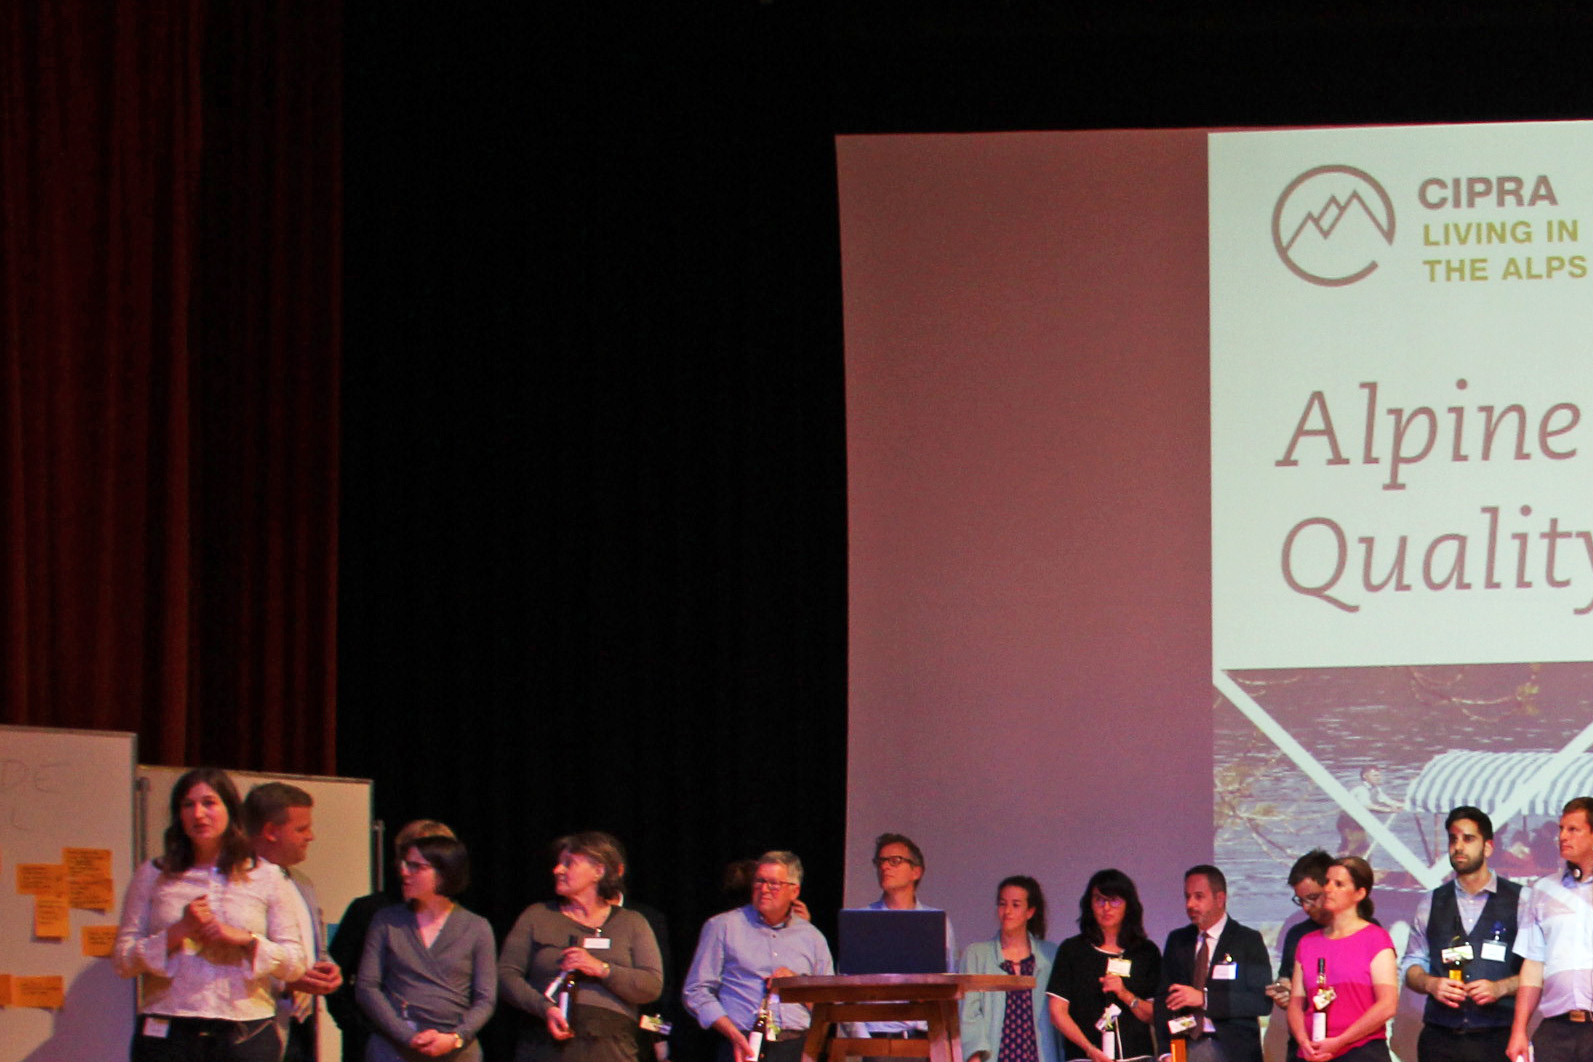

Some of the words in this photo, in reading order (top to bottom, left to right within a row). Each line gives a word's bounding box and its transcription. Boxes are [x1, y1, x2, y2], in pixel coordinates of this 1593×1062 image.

[1418, 175, 1559, 210] CIPRA
[1423, 220, 1533, 246] LIVING
[1547, 219, 1579, 243] IN
[1423, 258, 1489, 283] THE
[1502, 255, 1588, 281] ALPS
[1274, 378, 1583, 491] Alpine
